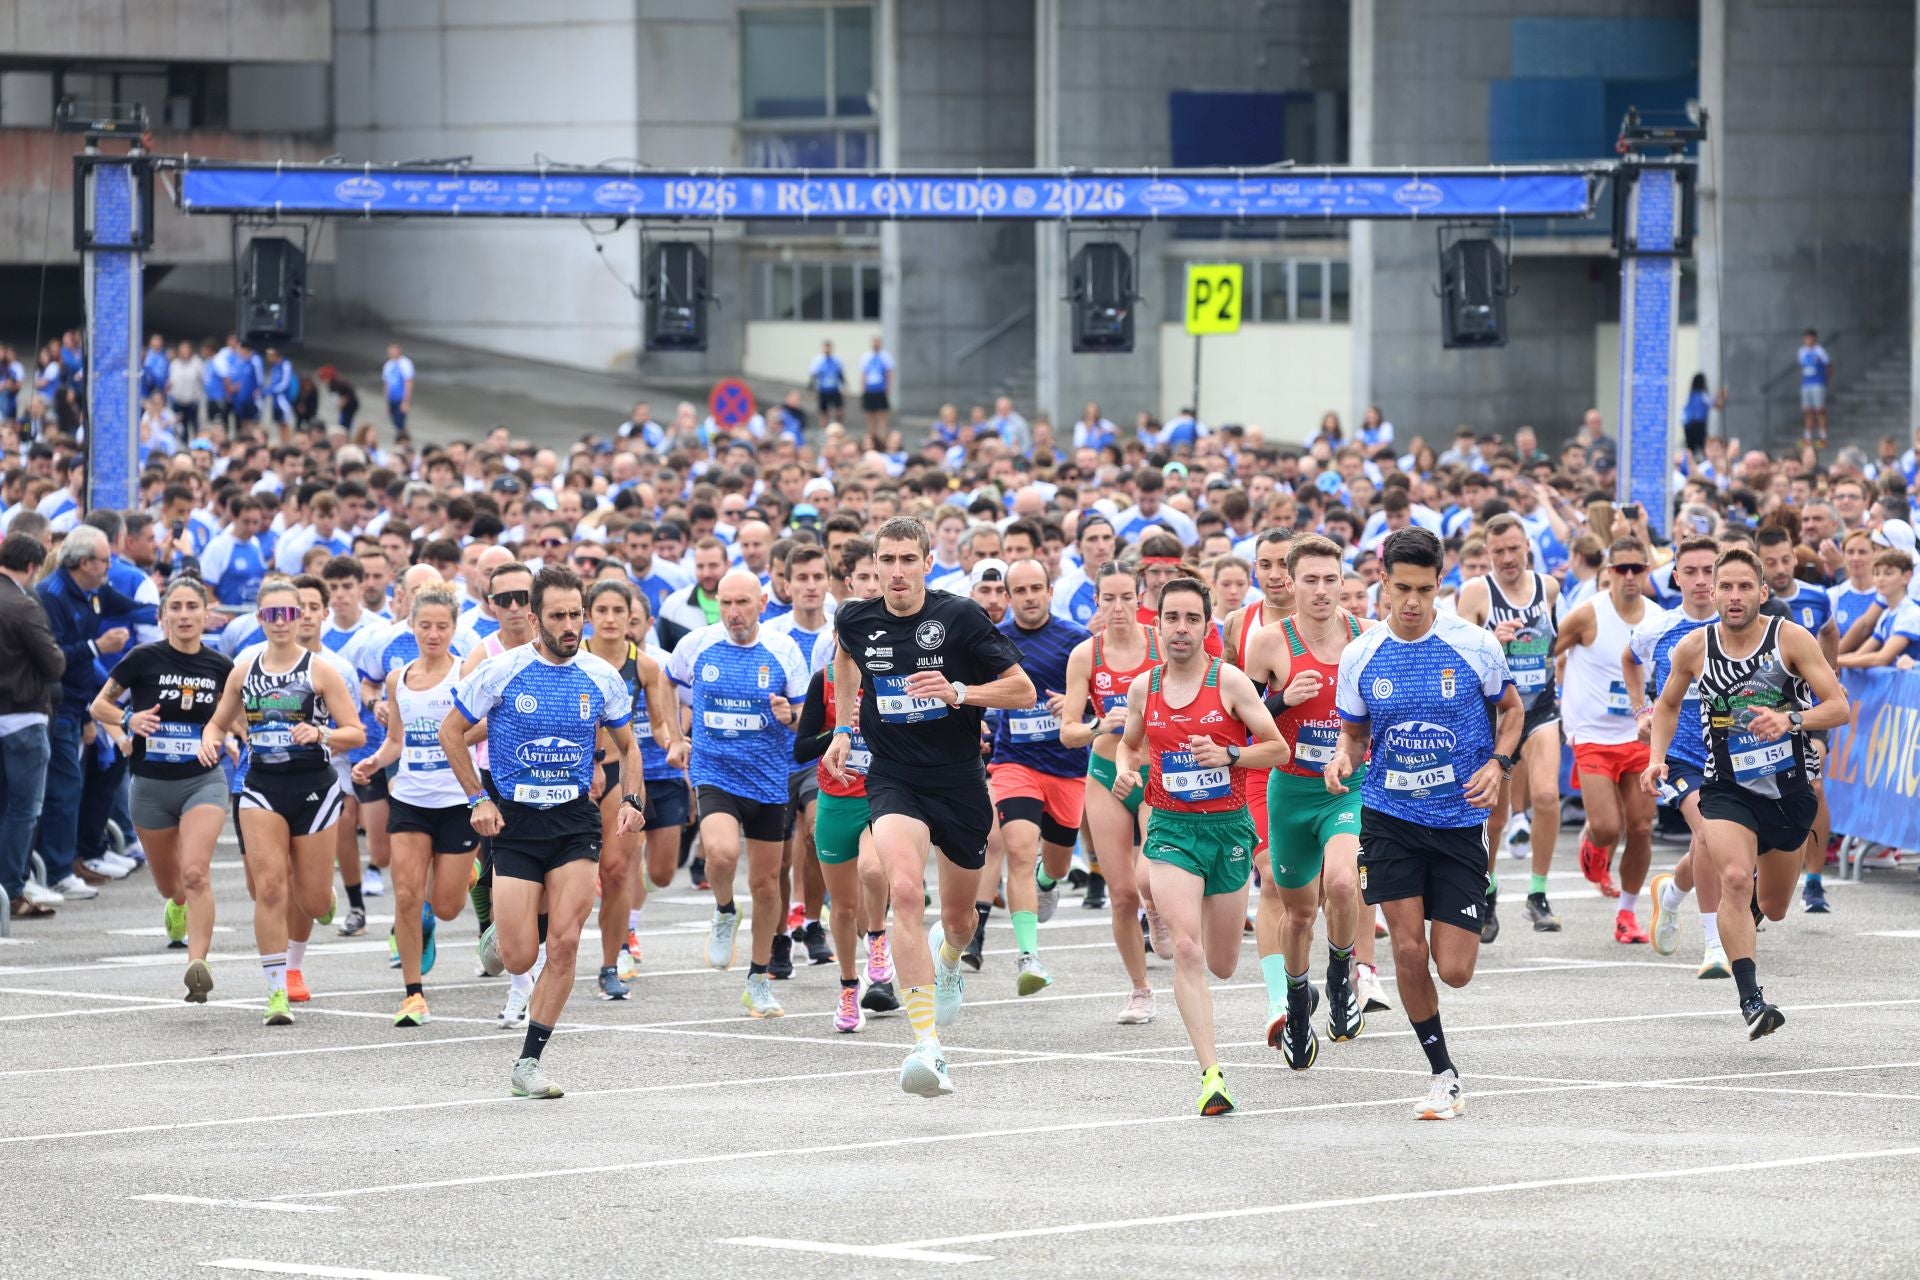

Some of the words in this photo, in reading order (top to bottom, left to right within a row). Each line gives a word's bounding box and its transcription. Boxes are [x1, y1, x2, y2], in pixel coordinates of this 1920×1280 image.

[664, 181, 737, 211] 1926
[777, 181, 866, 210] REAL
[871, 181, 1007, 212] OVIEDO
[1043, 181, 1125, 211] 2026
[1193, 278, 1233, 321] P2
[159, 673, 183, 687] REAL
[1728, 680, 1769, 695] RESTAURANTE
[158, 688, 181, 701] 19
[195, 691, 214, 704] 26
[714, 698, 752, 708] MARCHA
[735, 717, 748, 728] 81
[1036, 719, 1056, 730] 416
[174, 741, 193, 752] 517
[1387, 730, 1453, 750] ASTURIANA
[520, 746, 580, 763] ASTURIANA
[1395, 752, 1437, 765] MARCHA
[1765, 746, 1785, 762] 154
[530, 769, 570, 778] MARCHA
[1195, 770, 1224, 787] 430
[1416, 770, 1446, 786] 405
[545, 787, 573, 801] 560
